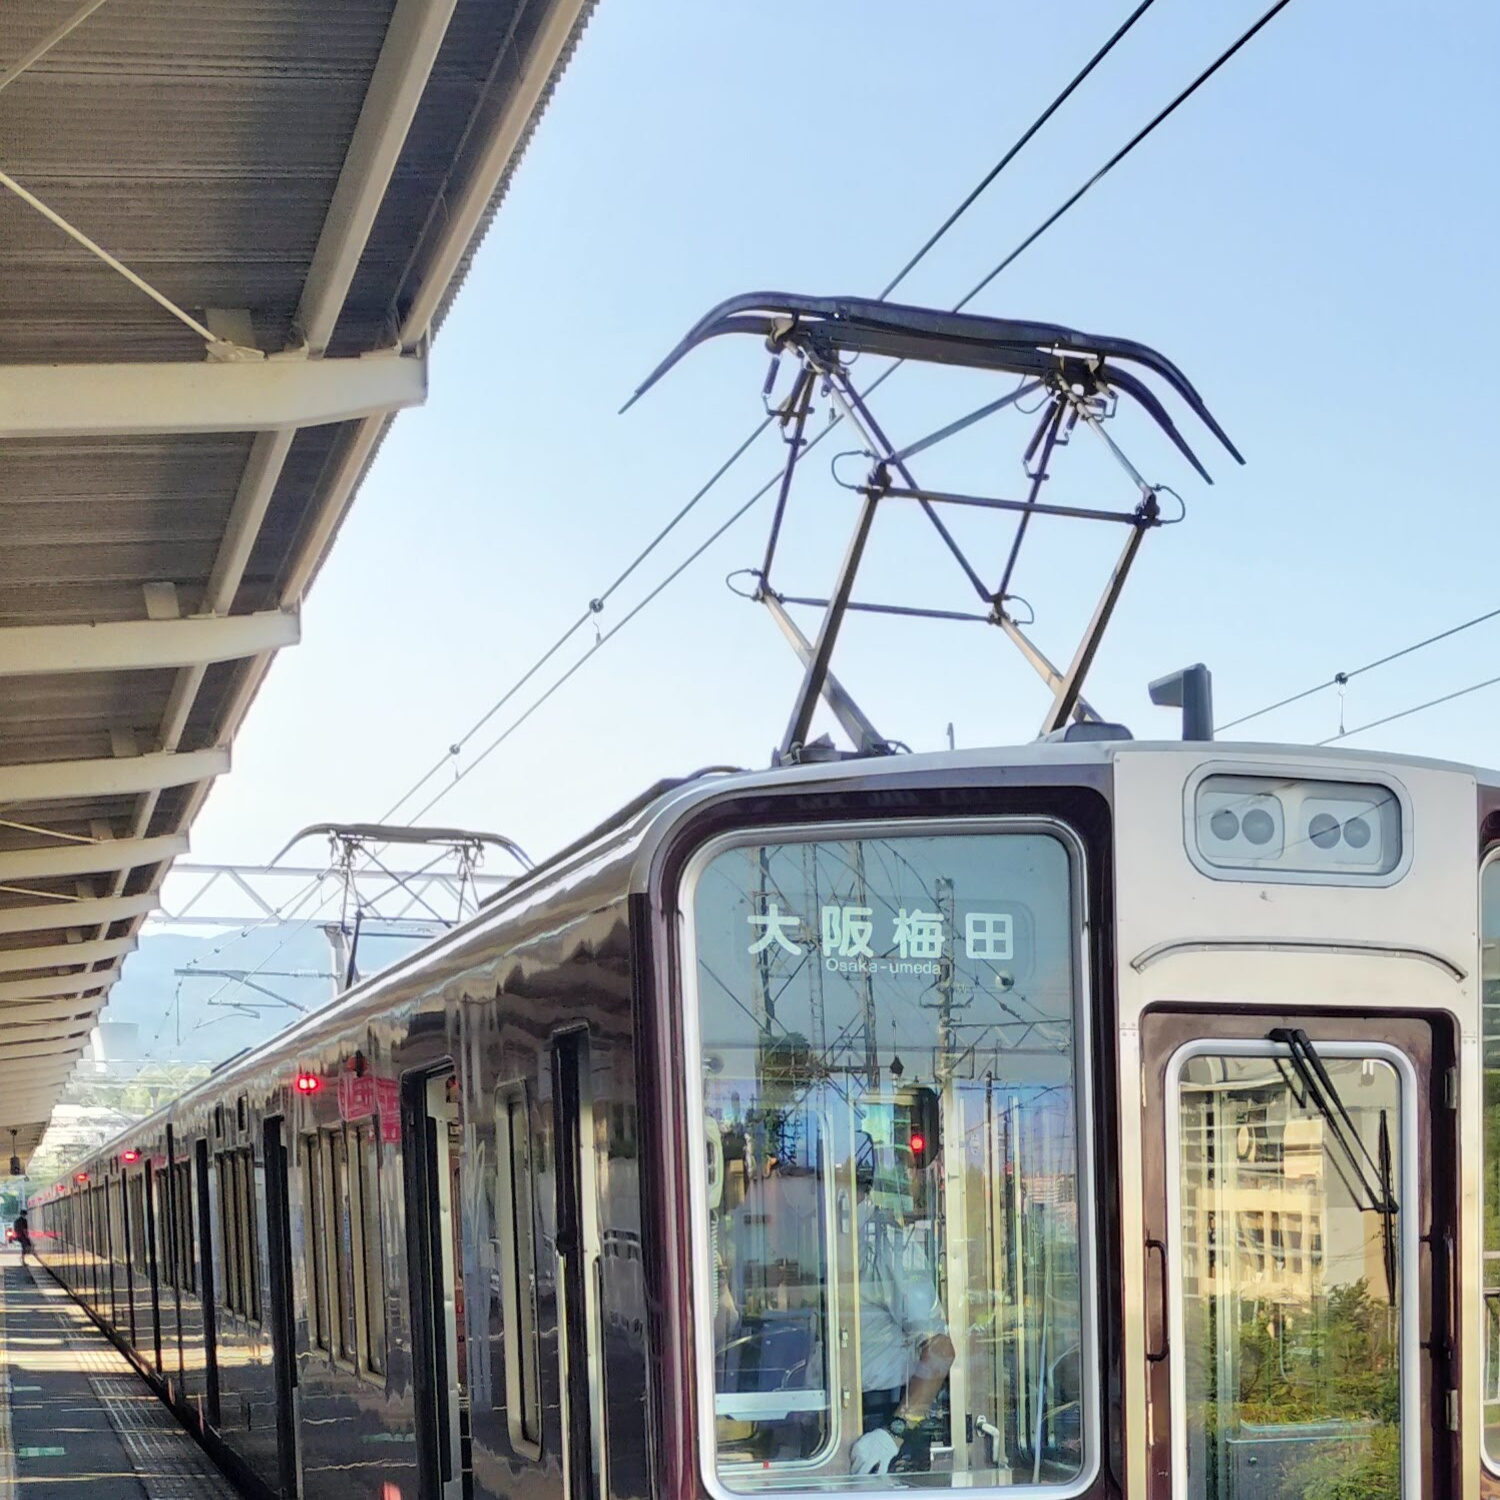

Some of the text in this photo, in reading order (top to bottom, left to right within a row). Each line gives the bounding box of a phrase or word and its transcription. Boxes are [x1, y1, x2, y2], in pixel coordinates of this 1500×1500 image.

[746, 903, 1014, 961] 大阪梅田
[826, 958, 941, 975] Osaka-umeda
